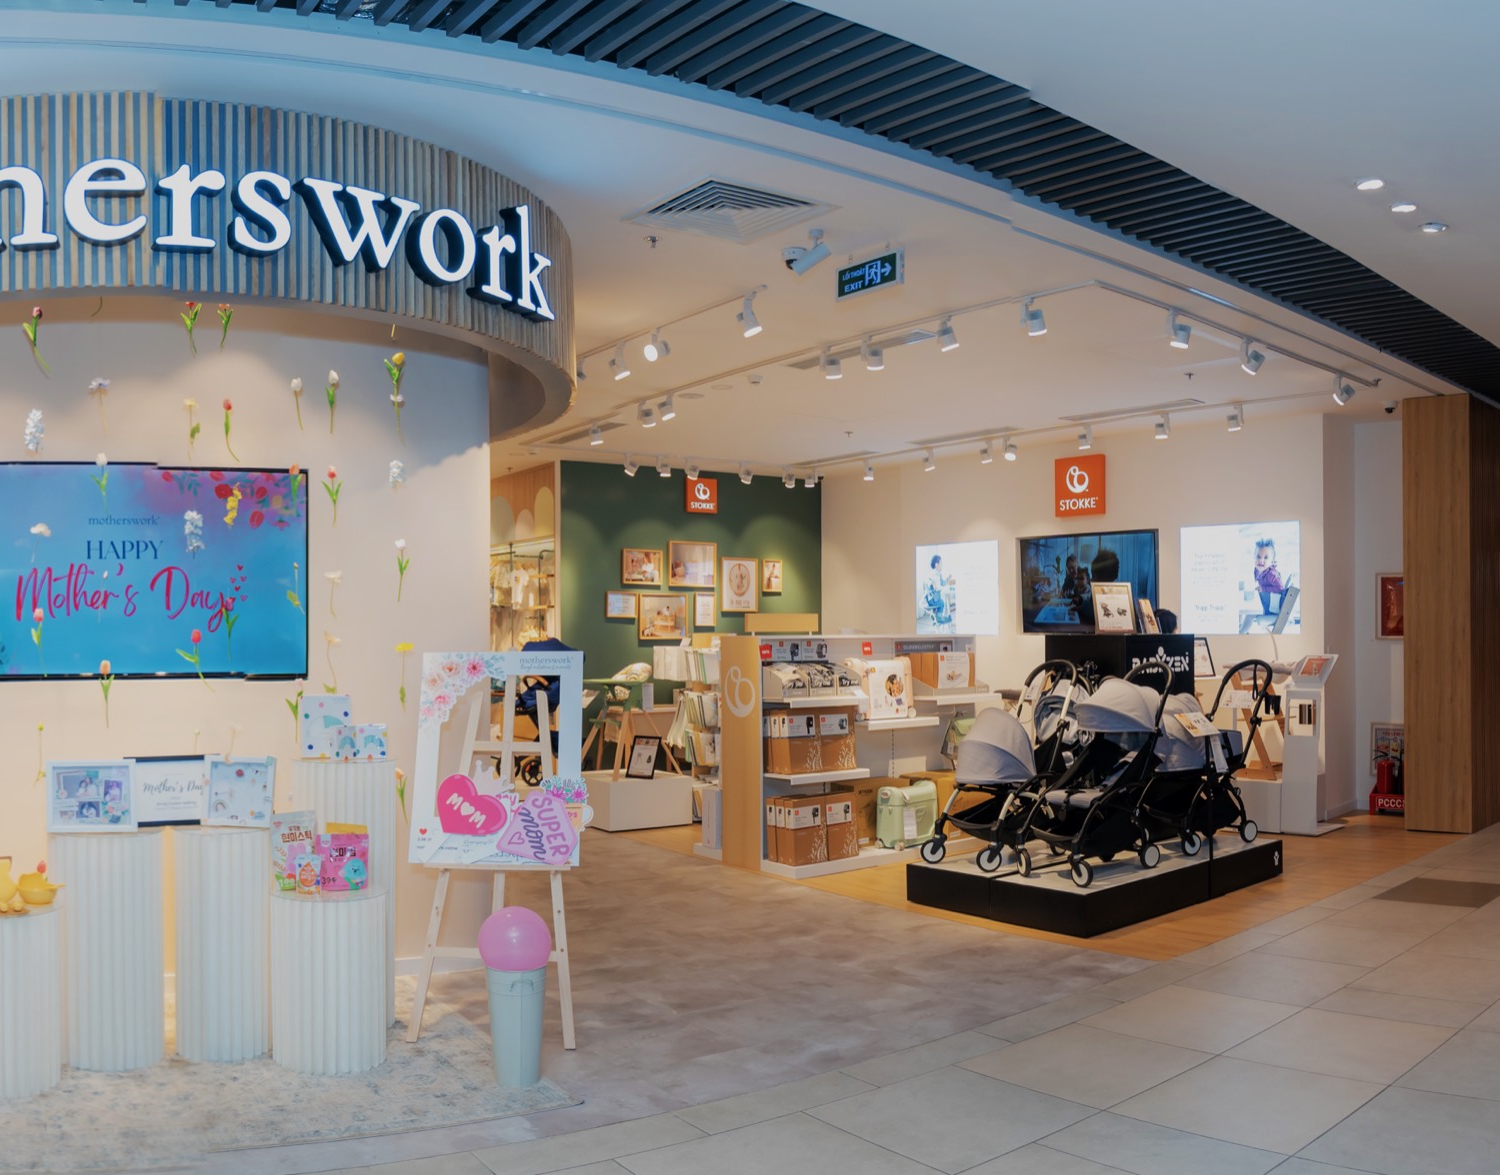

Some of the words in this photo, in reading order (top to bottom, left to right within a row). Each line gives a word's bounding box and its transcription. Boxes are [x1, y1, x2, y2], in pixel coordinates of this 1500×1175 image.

[844, 280, 863, 293] EXIT
[690, 501, 715, 510] STOKKE
[1059, 497, 1098, 511] STOKKE
[88, 514, 161, 526] motherswork
[86, 539, 164, 560] HAPPY
[15, 562, 139, 622] Mother's
[149, 565, 237, 633] Day
[519, 655, 573, 665] motherswork
[143, 778, 184, 795] Mother's
[531, 796, 570, 857] SUPER
